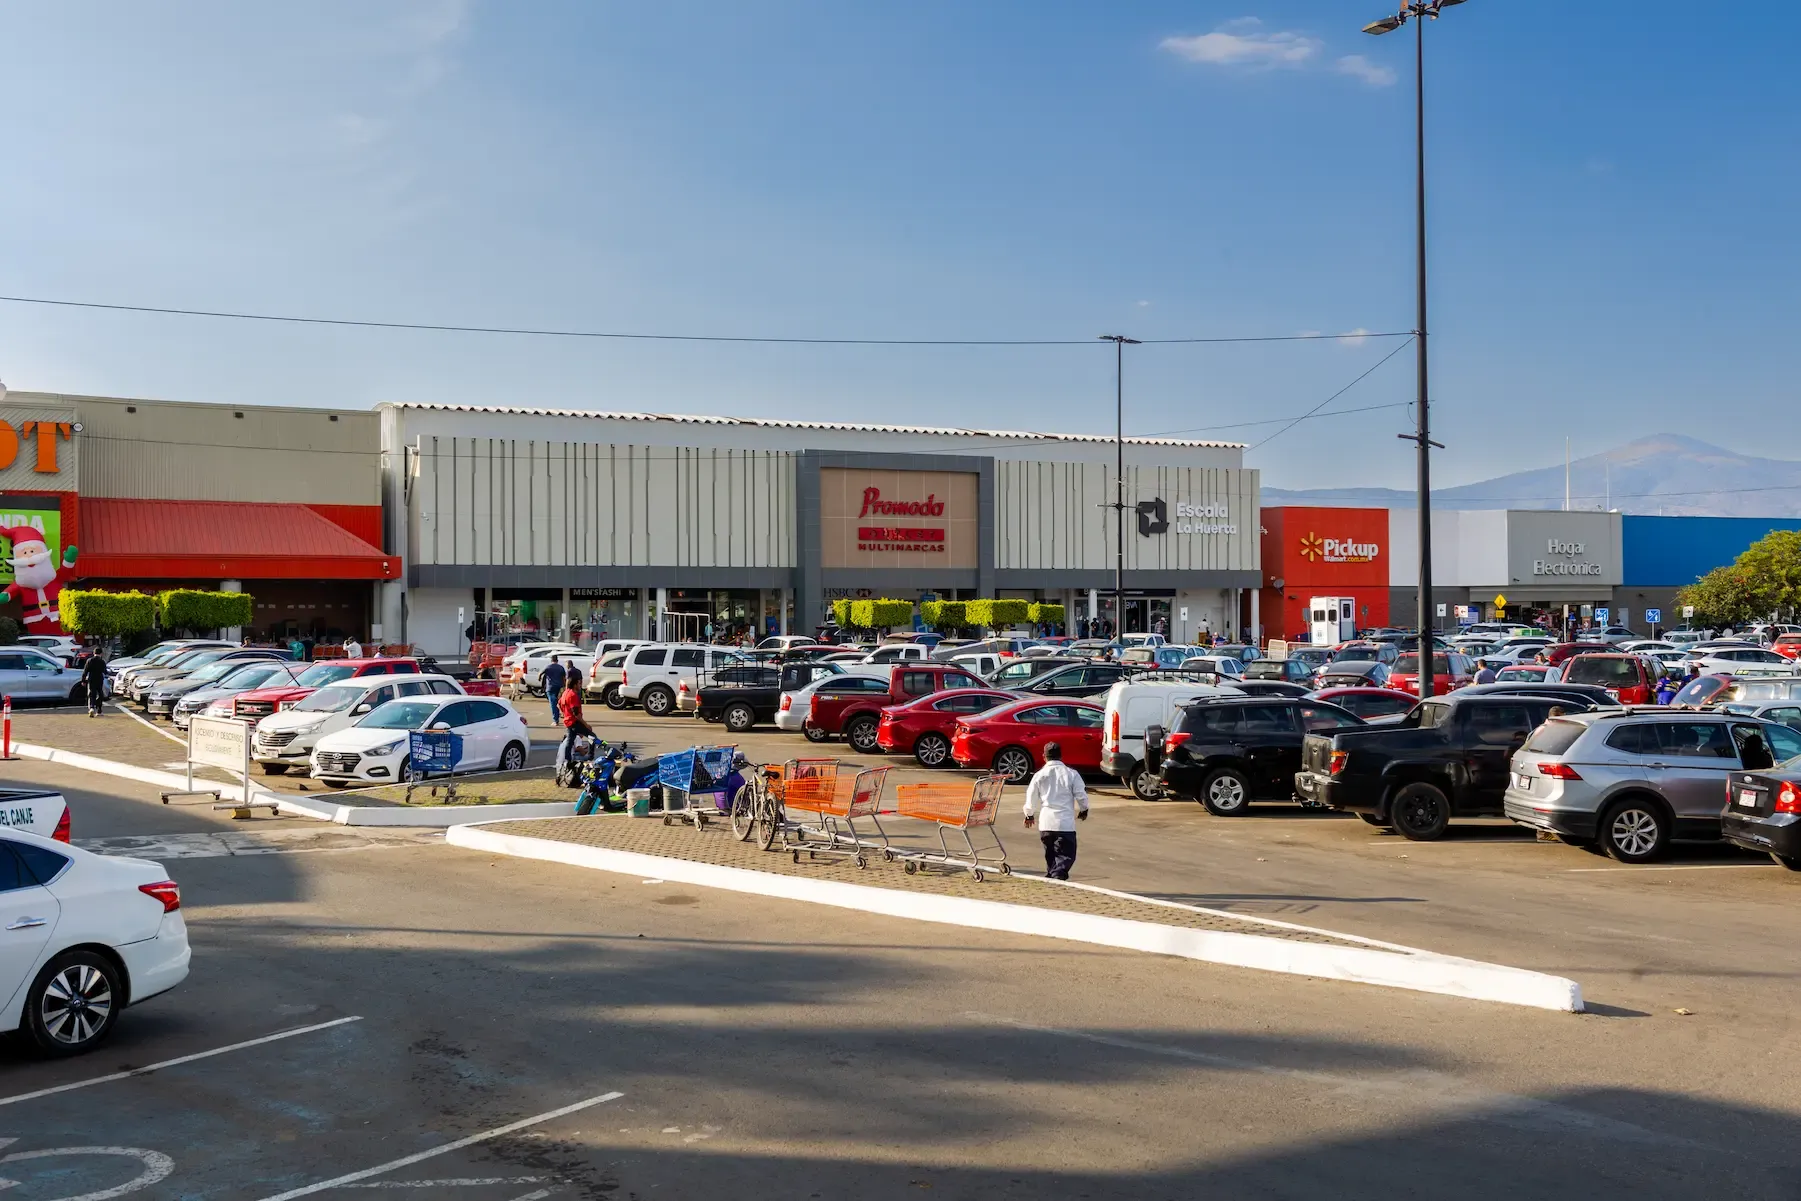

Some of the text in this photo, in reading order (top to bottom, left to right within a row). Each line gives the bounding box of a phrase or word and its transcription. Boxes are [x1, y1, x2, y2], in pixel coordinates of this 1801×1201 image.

[858, 486, 945, 519] Promoda
[1176, 501, 1229, 518] Escala
[1176, 521, 1237, 535] La Huerta
[858, 543, 945, 552] MULTIMARCAS
[1323, 538, 1379, 561] Pickup
[1547, 539, 1585, 558] Hogar
[1533, 560, 1602, 575] Electrónica
[823, 587, 853, 598] HSBC
[11, 807, 34, 826] CANJE
